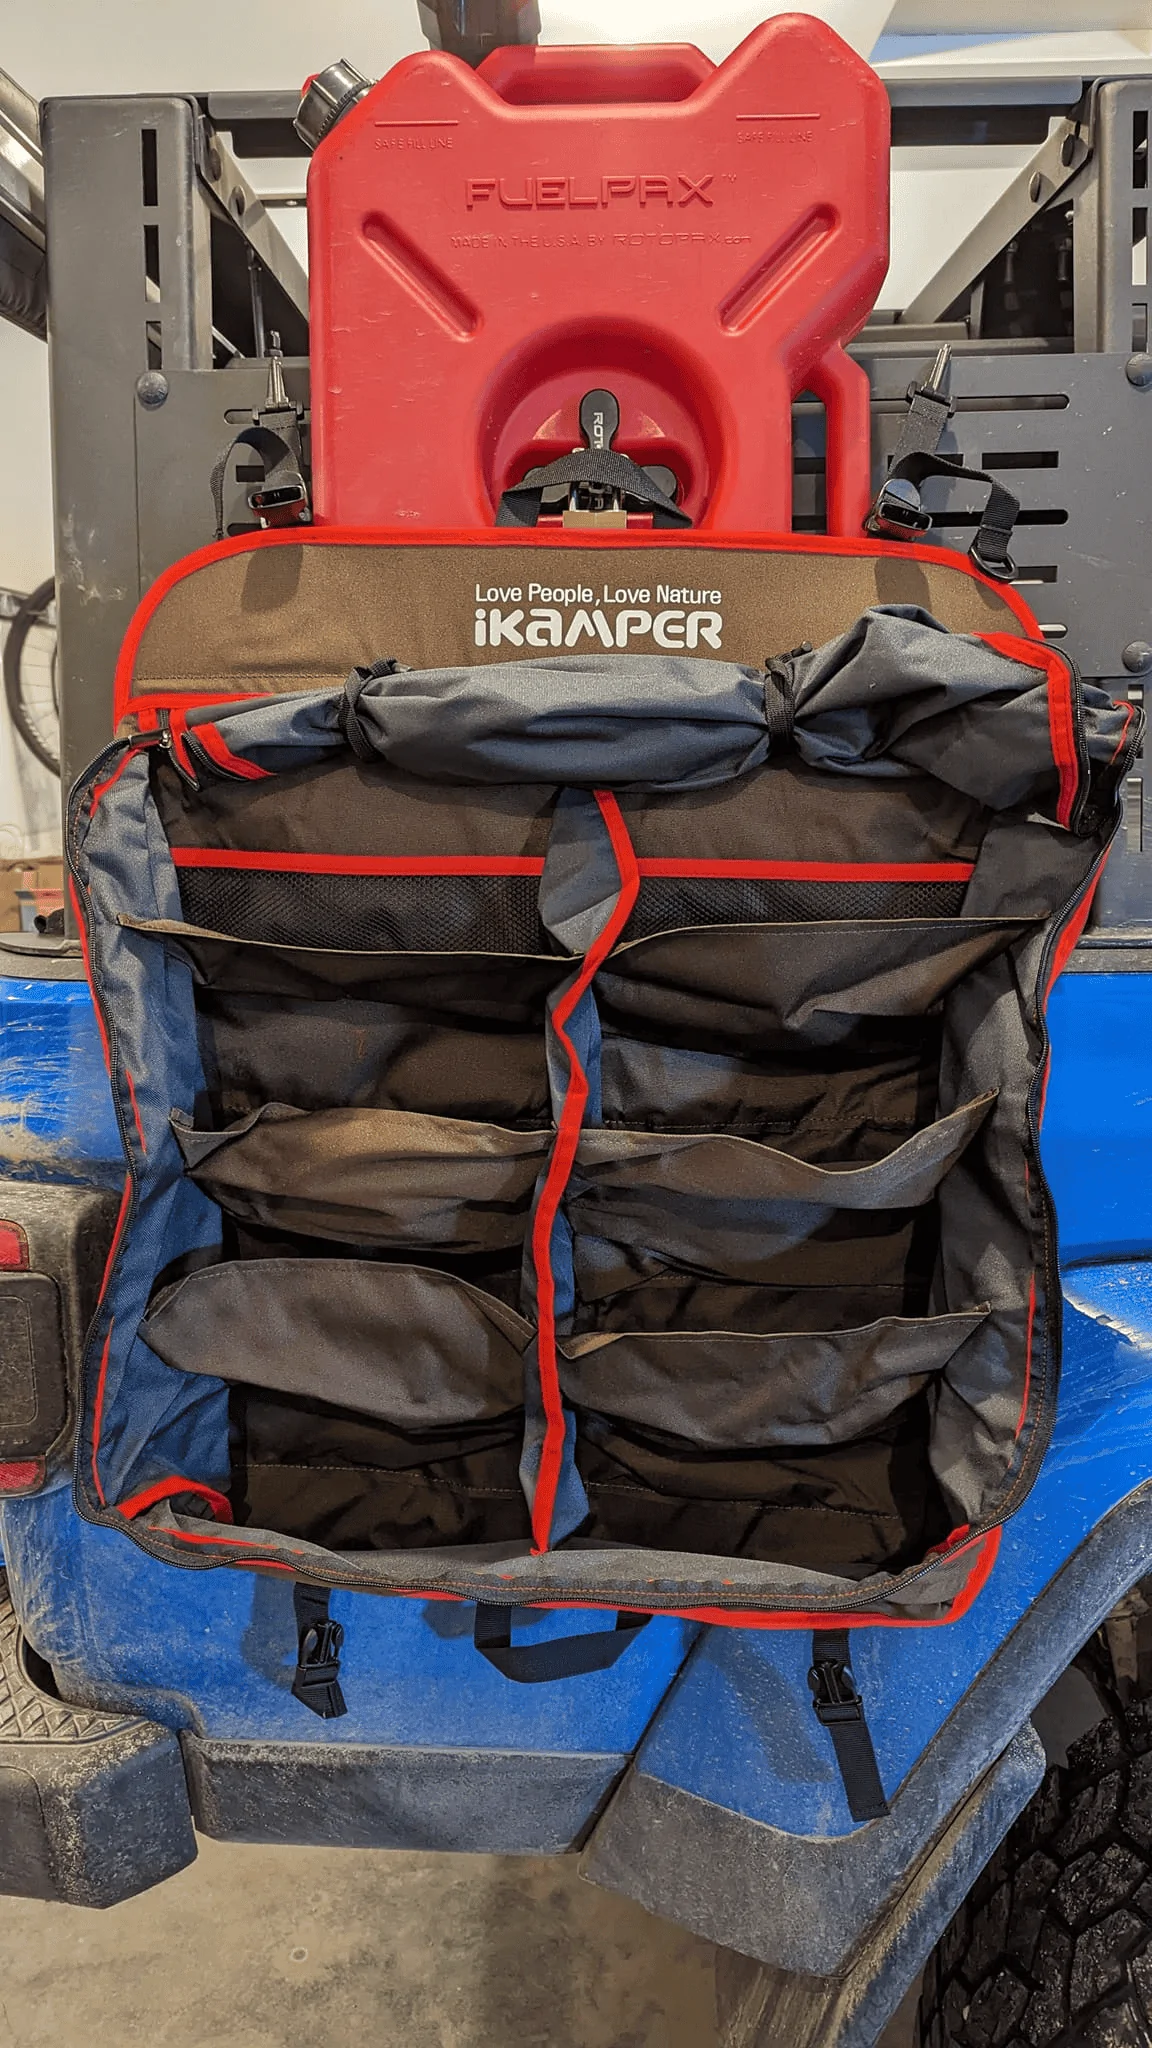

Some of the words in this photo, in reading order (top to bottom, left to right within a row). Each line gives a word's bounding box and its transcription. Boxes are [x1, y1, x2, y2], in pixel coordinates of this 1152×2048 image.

[375, 138, 404, 150] SAFE
[407, 137, 427, 150] FILL
[429, 136, 453, 150] LINE
[465, 174, 715, 211] FUELPAX
[450, 235, 489, 249] MADE
[494, 236, 508, 249] IN
[511, 235, 540, 249] THE
[587, 234, 605, 248] BY
[475, 584, 522, 603] Love
[528, 583, 600, 607] People,
[603, 585, 651, 605] Love
[656, 584, 722, 605] Nature
